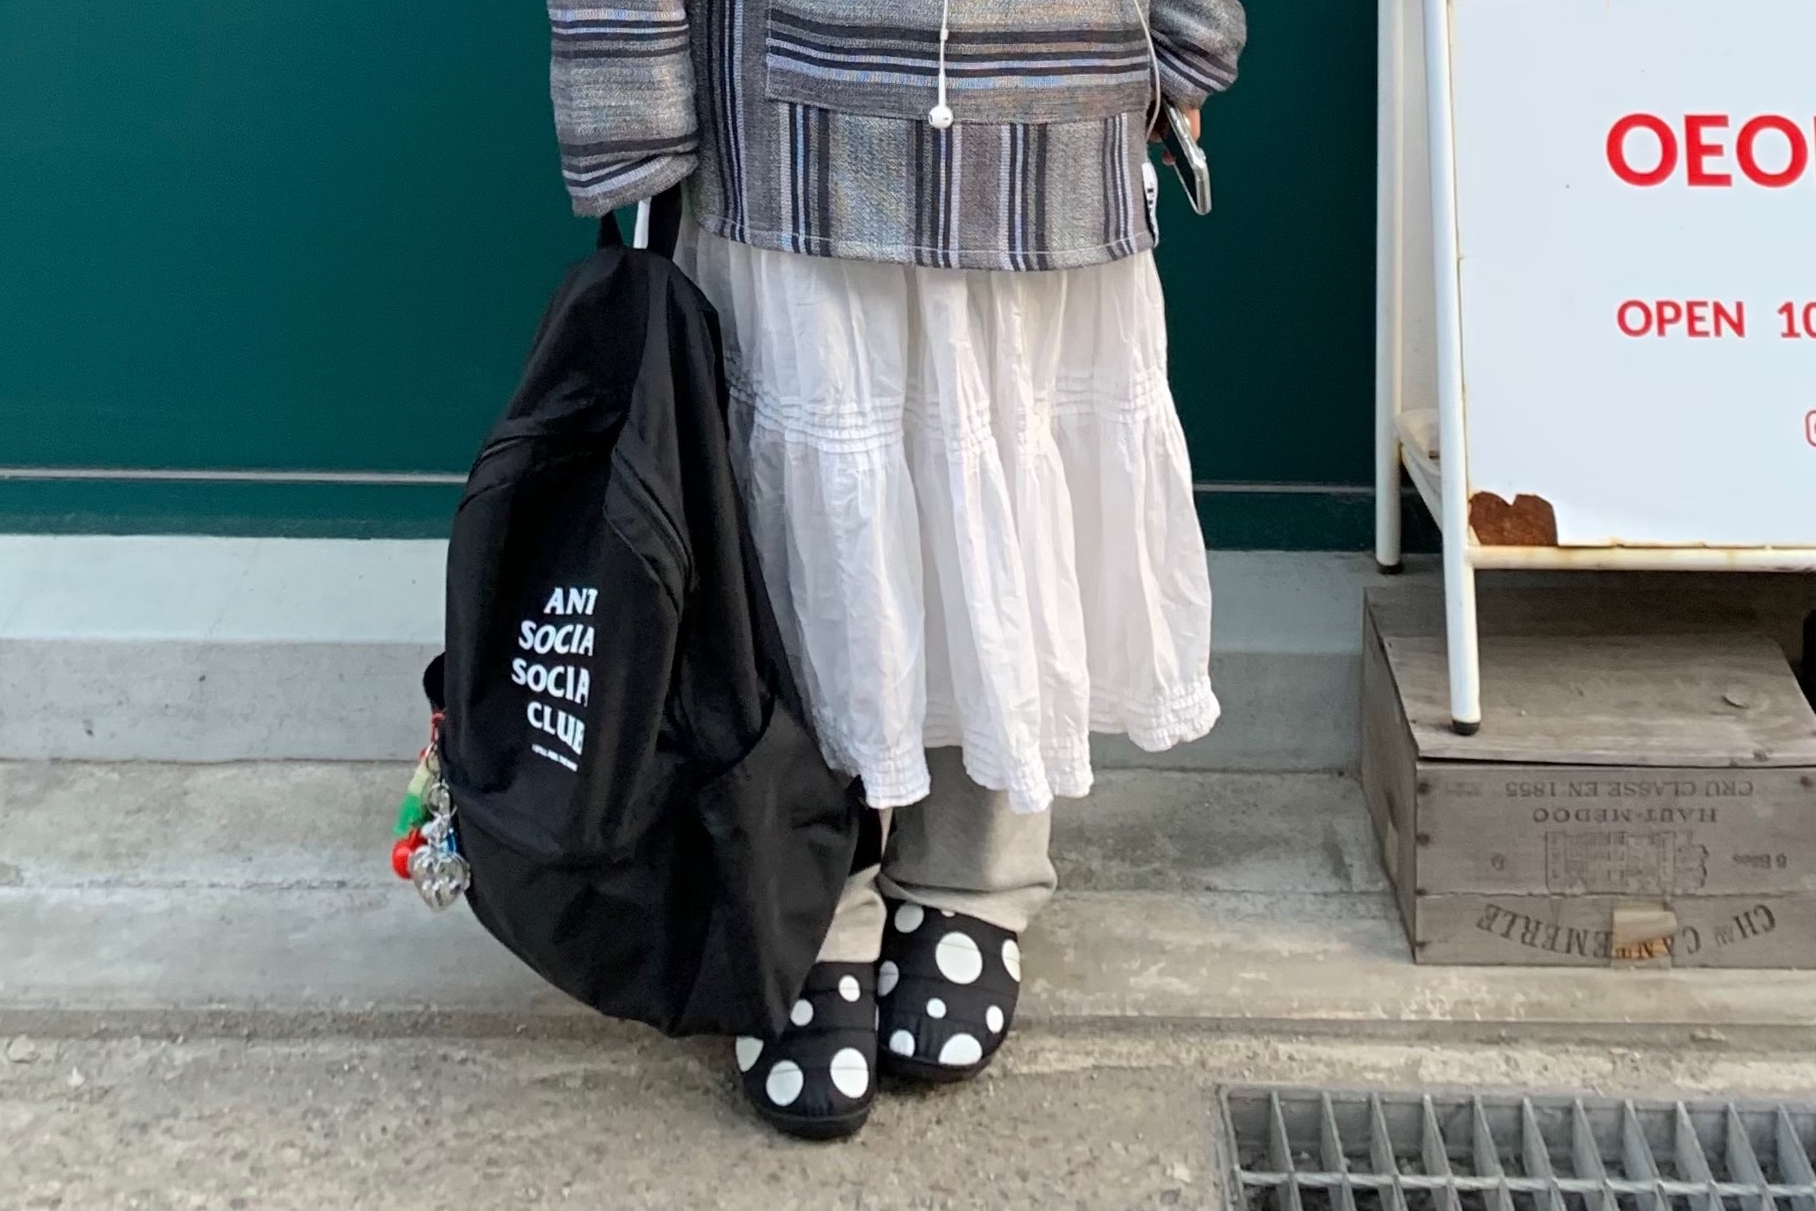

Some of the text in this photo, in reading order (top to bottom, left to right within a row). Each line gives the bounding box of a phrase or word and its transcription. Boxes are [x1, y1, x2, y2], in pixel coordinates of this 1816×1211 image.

[1606, 113, 1816, 187] OEO
[1616, 299, 1745, 338] OPEN
[1504, 780, 1557, 798] 1855
[1567, 780, 1600, 797] EN
[1705, 780, 1754, 797] CRU
